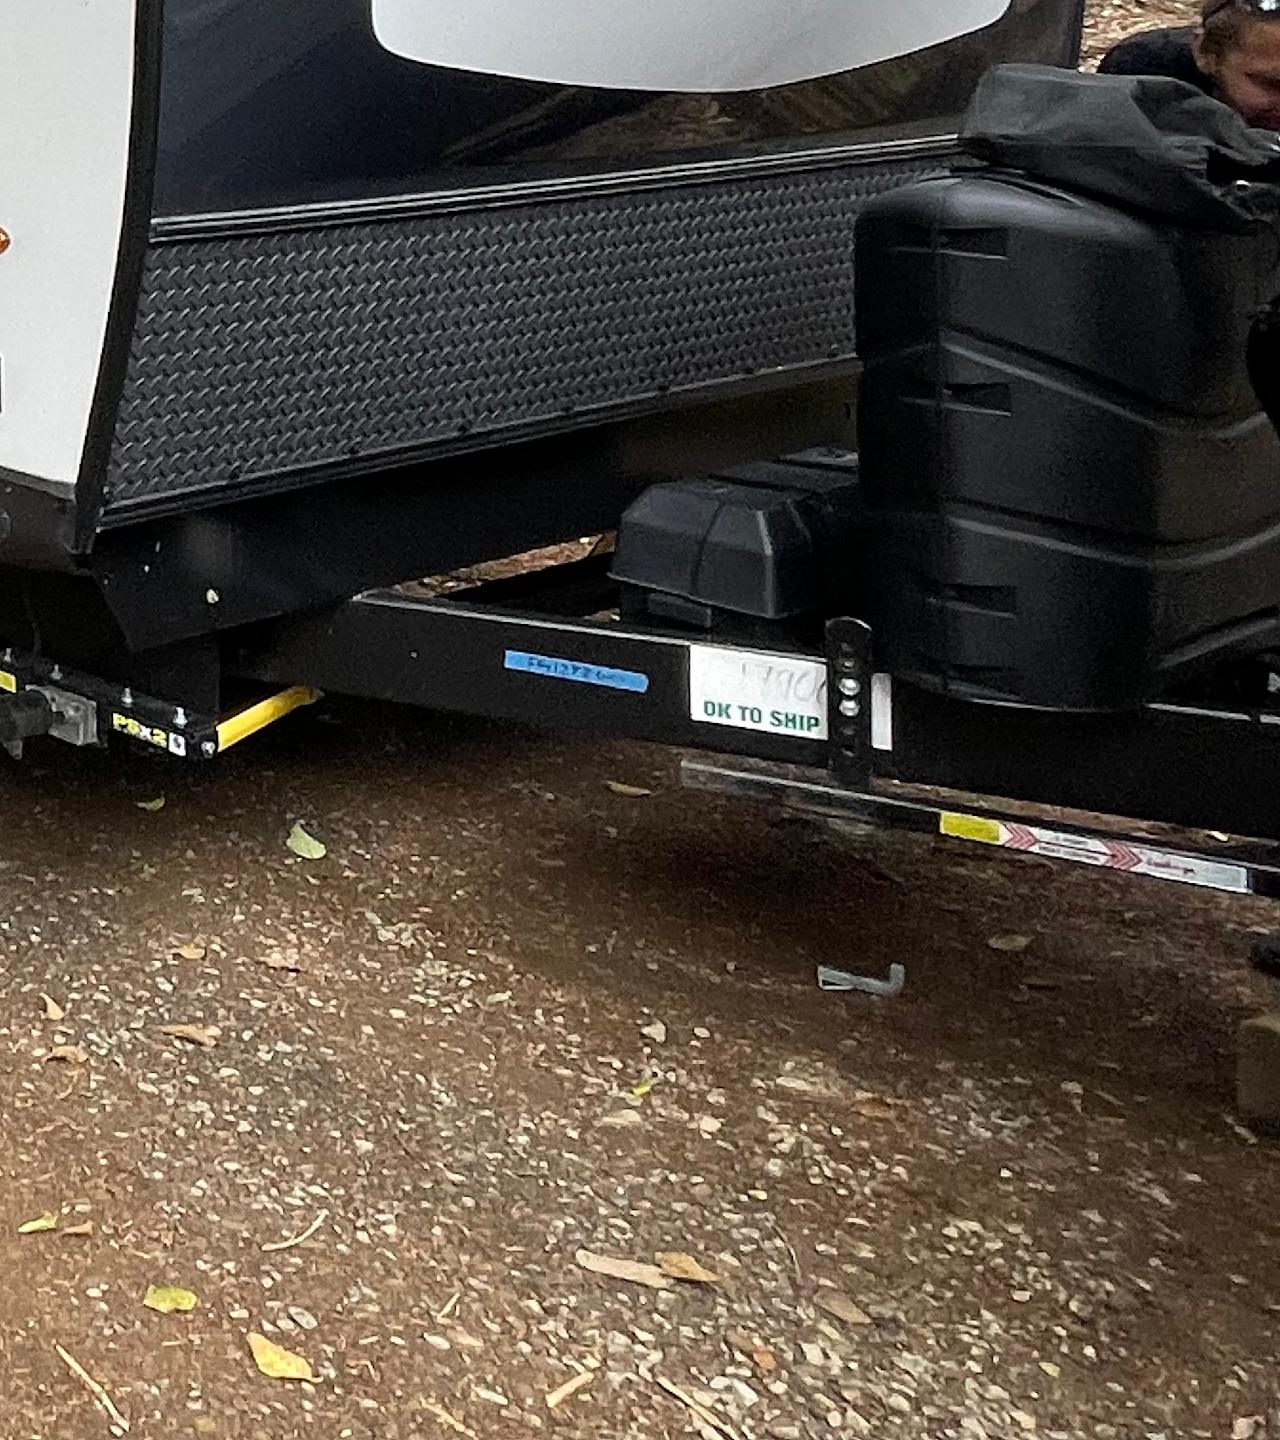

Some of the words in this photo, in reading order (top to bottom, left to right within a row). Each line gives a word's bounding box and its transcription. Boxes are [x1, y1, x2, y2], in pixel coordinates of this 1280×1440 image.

[703, 700, 732, 719] OK
[738, 705, 762, 724] TO
[769, 710, 820, 732] SHIP
